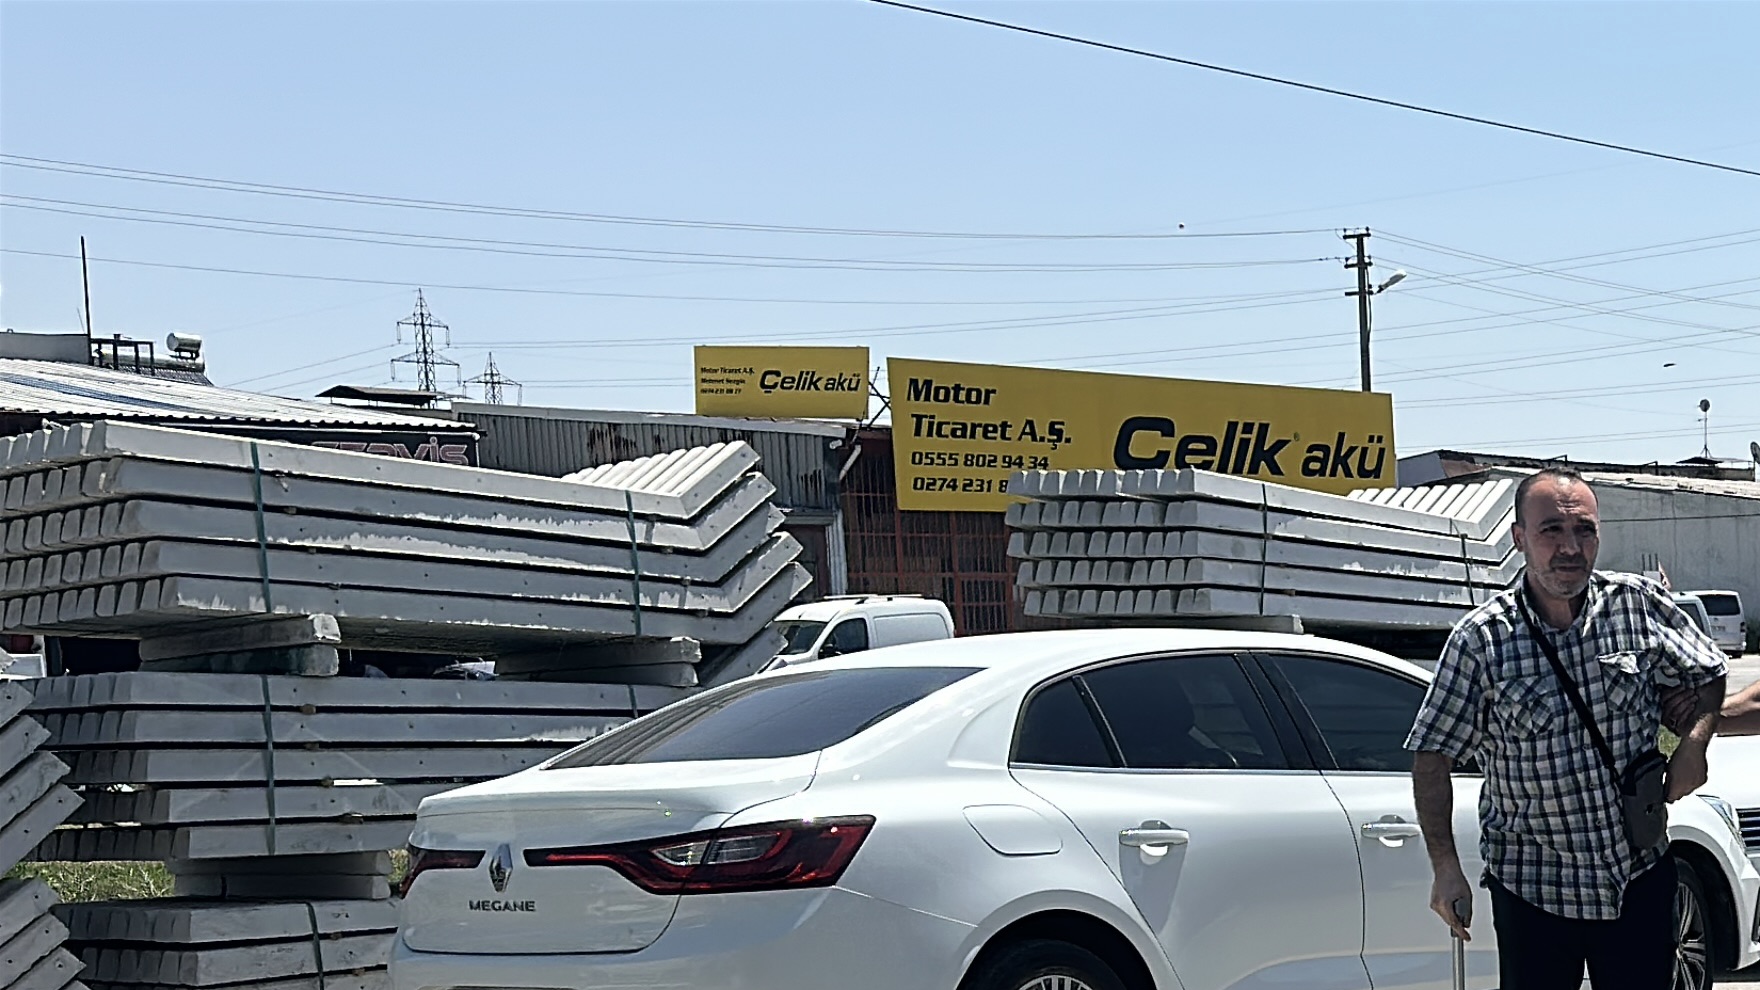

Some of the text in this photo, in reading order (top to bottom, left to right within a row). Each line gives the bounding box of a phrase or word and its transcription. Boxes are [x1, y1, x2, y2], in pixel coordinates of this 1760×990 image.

[759, 370, 861, 394] Çelik akü
[906, 377, 997, 406] Motor
[911, 413, 1072, 450] Ticaret A.Ş.
[911, 451, 1049, 470] 0555 802 94 34
[1301, 431, 1386, 479] akü
[912, 477, 958, 491] 0274
[962, 478, 993, 493] 231
[469, 900, 536, 912] MEGANE
